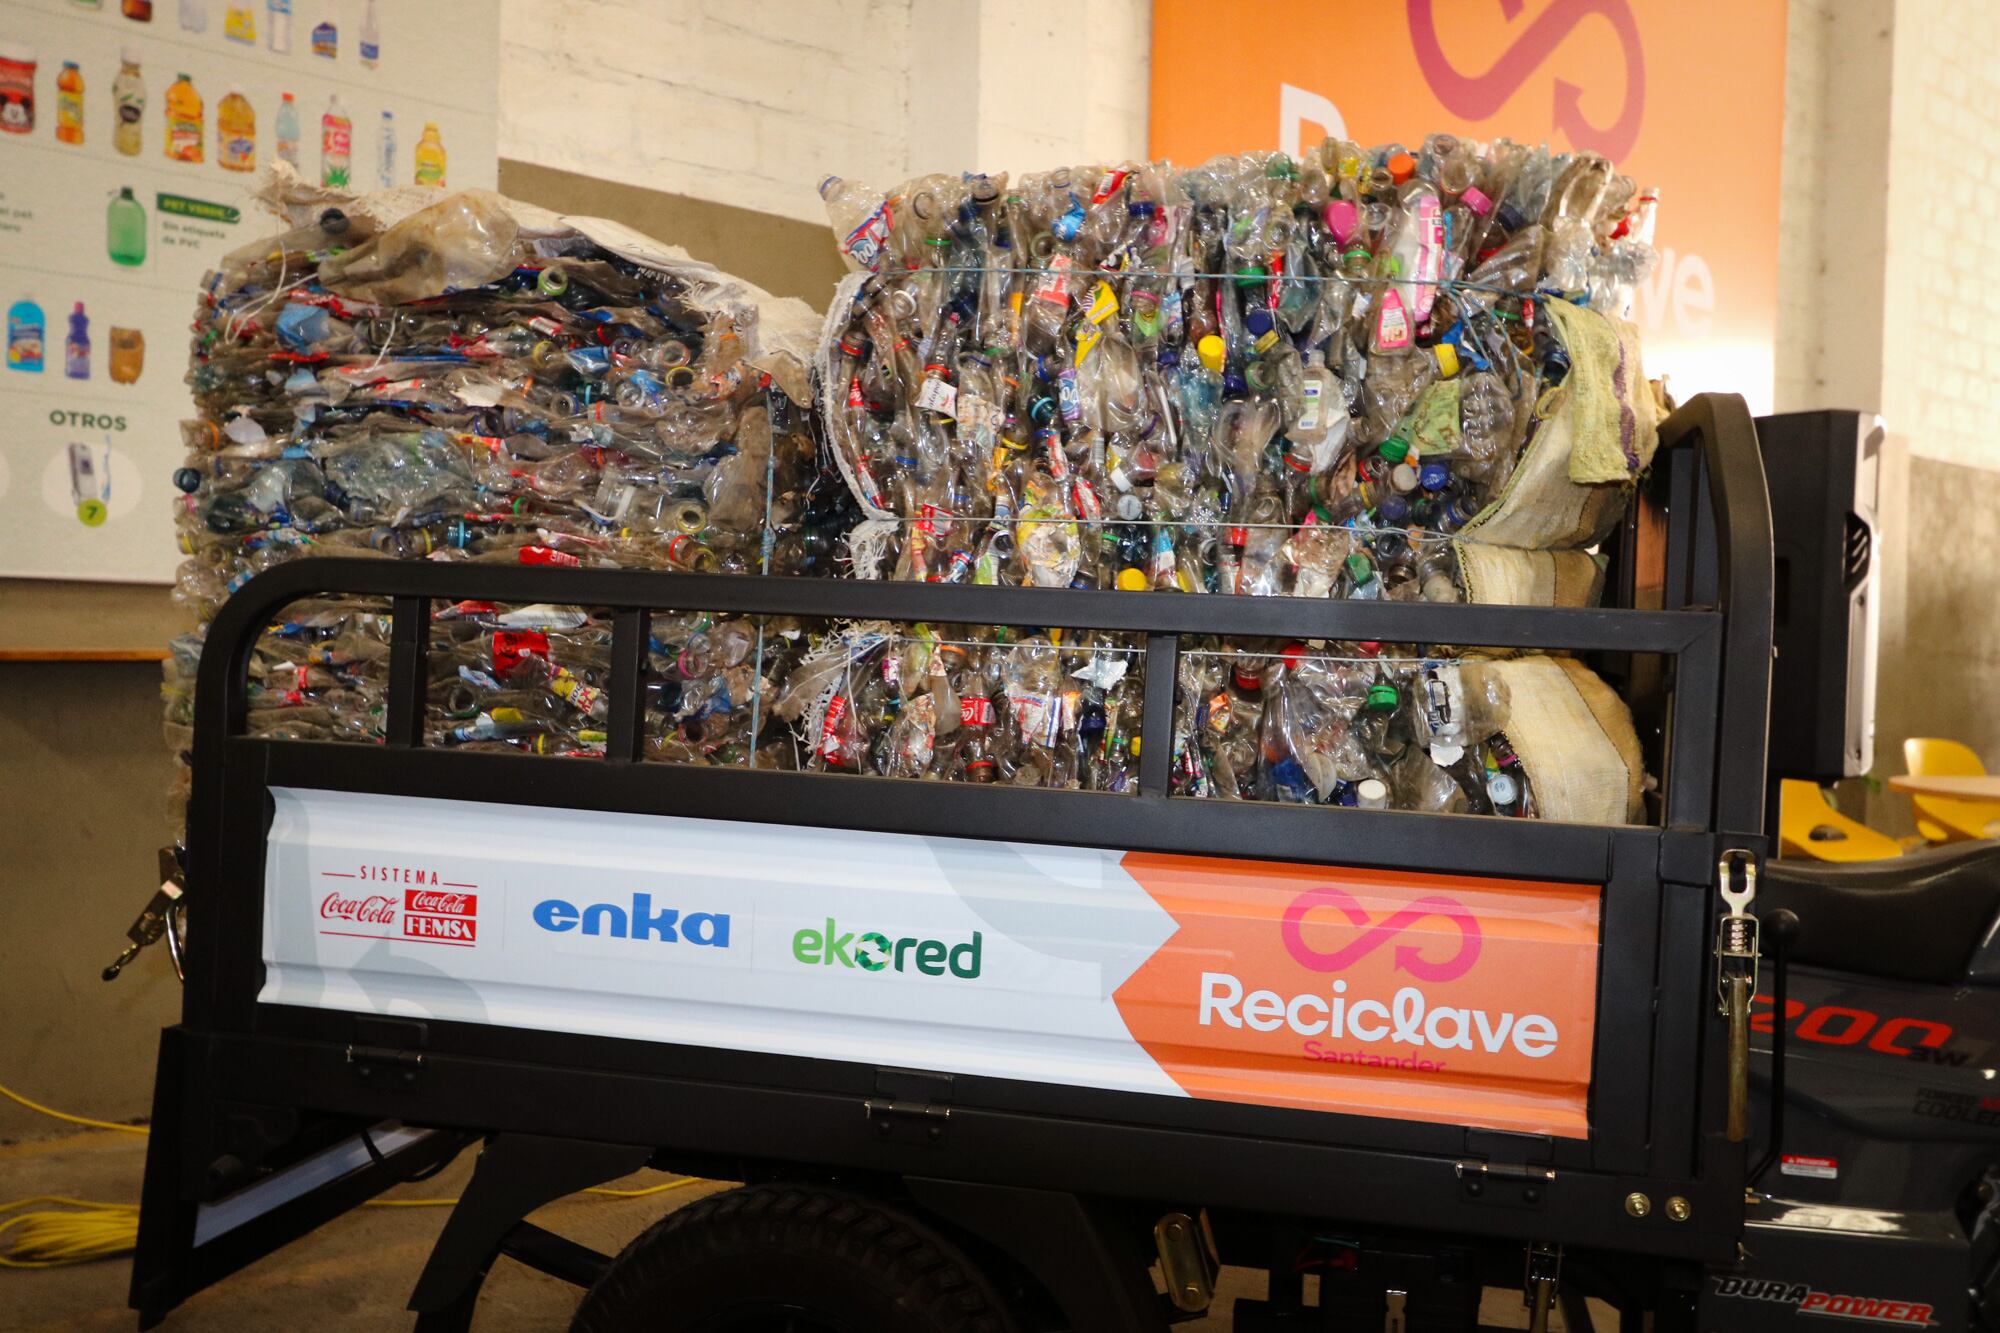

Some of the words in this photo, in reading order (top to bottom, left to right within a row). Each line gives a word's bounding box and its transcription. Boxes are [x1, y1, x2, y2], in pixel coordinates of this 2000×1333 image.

[49, 410, 128, 432] OTROS
[87, 507, 99, 521] 7
[360, 865, 438, 886] SISTEMA
[406, 915, 473, 940] FEMSA
[532, 892, 731, 949] enka
[1198, 971, 1559, 1059] Reciclave
[1749, 994, 1954, 1056] 200
[1302, 1040, 1447, 1074] Santander
